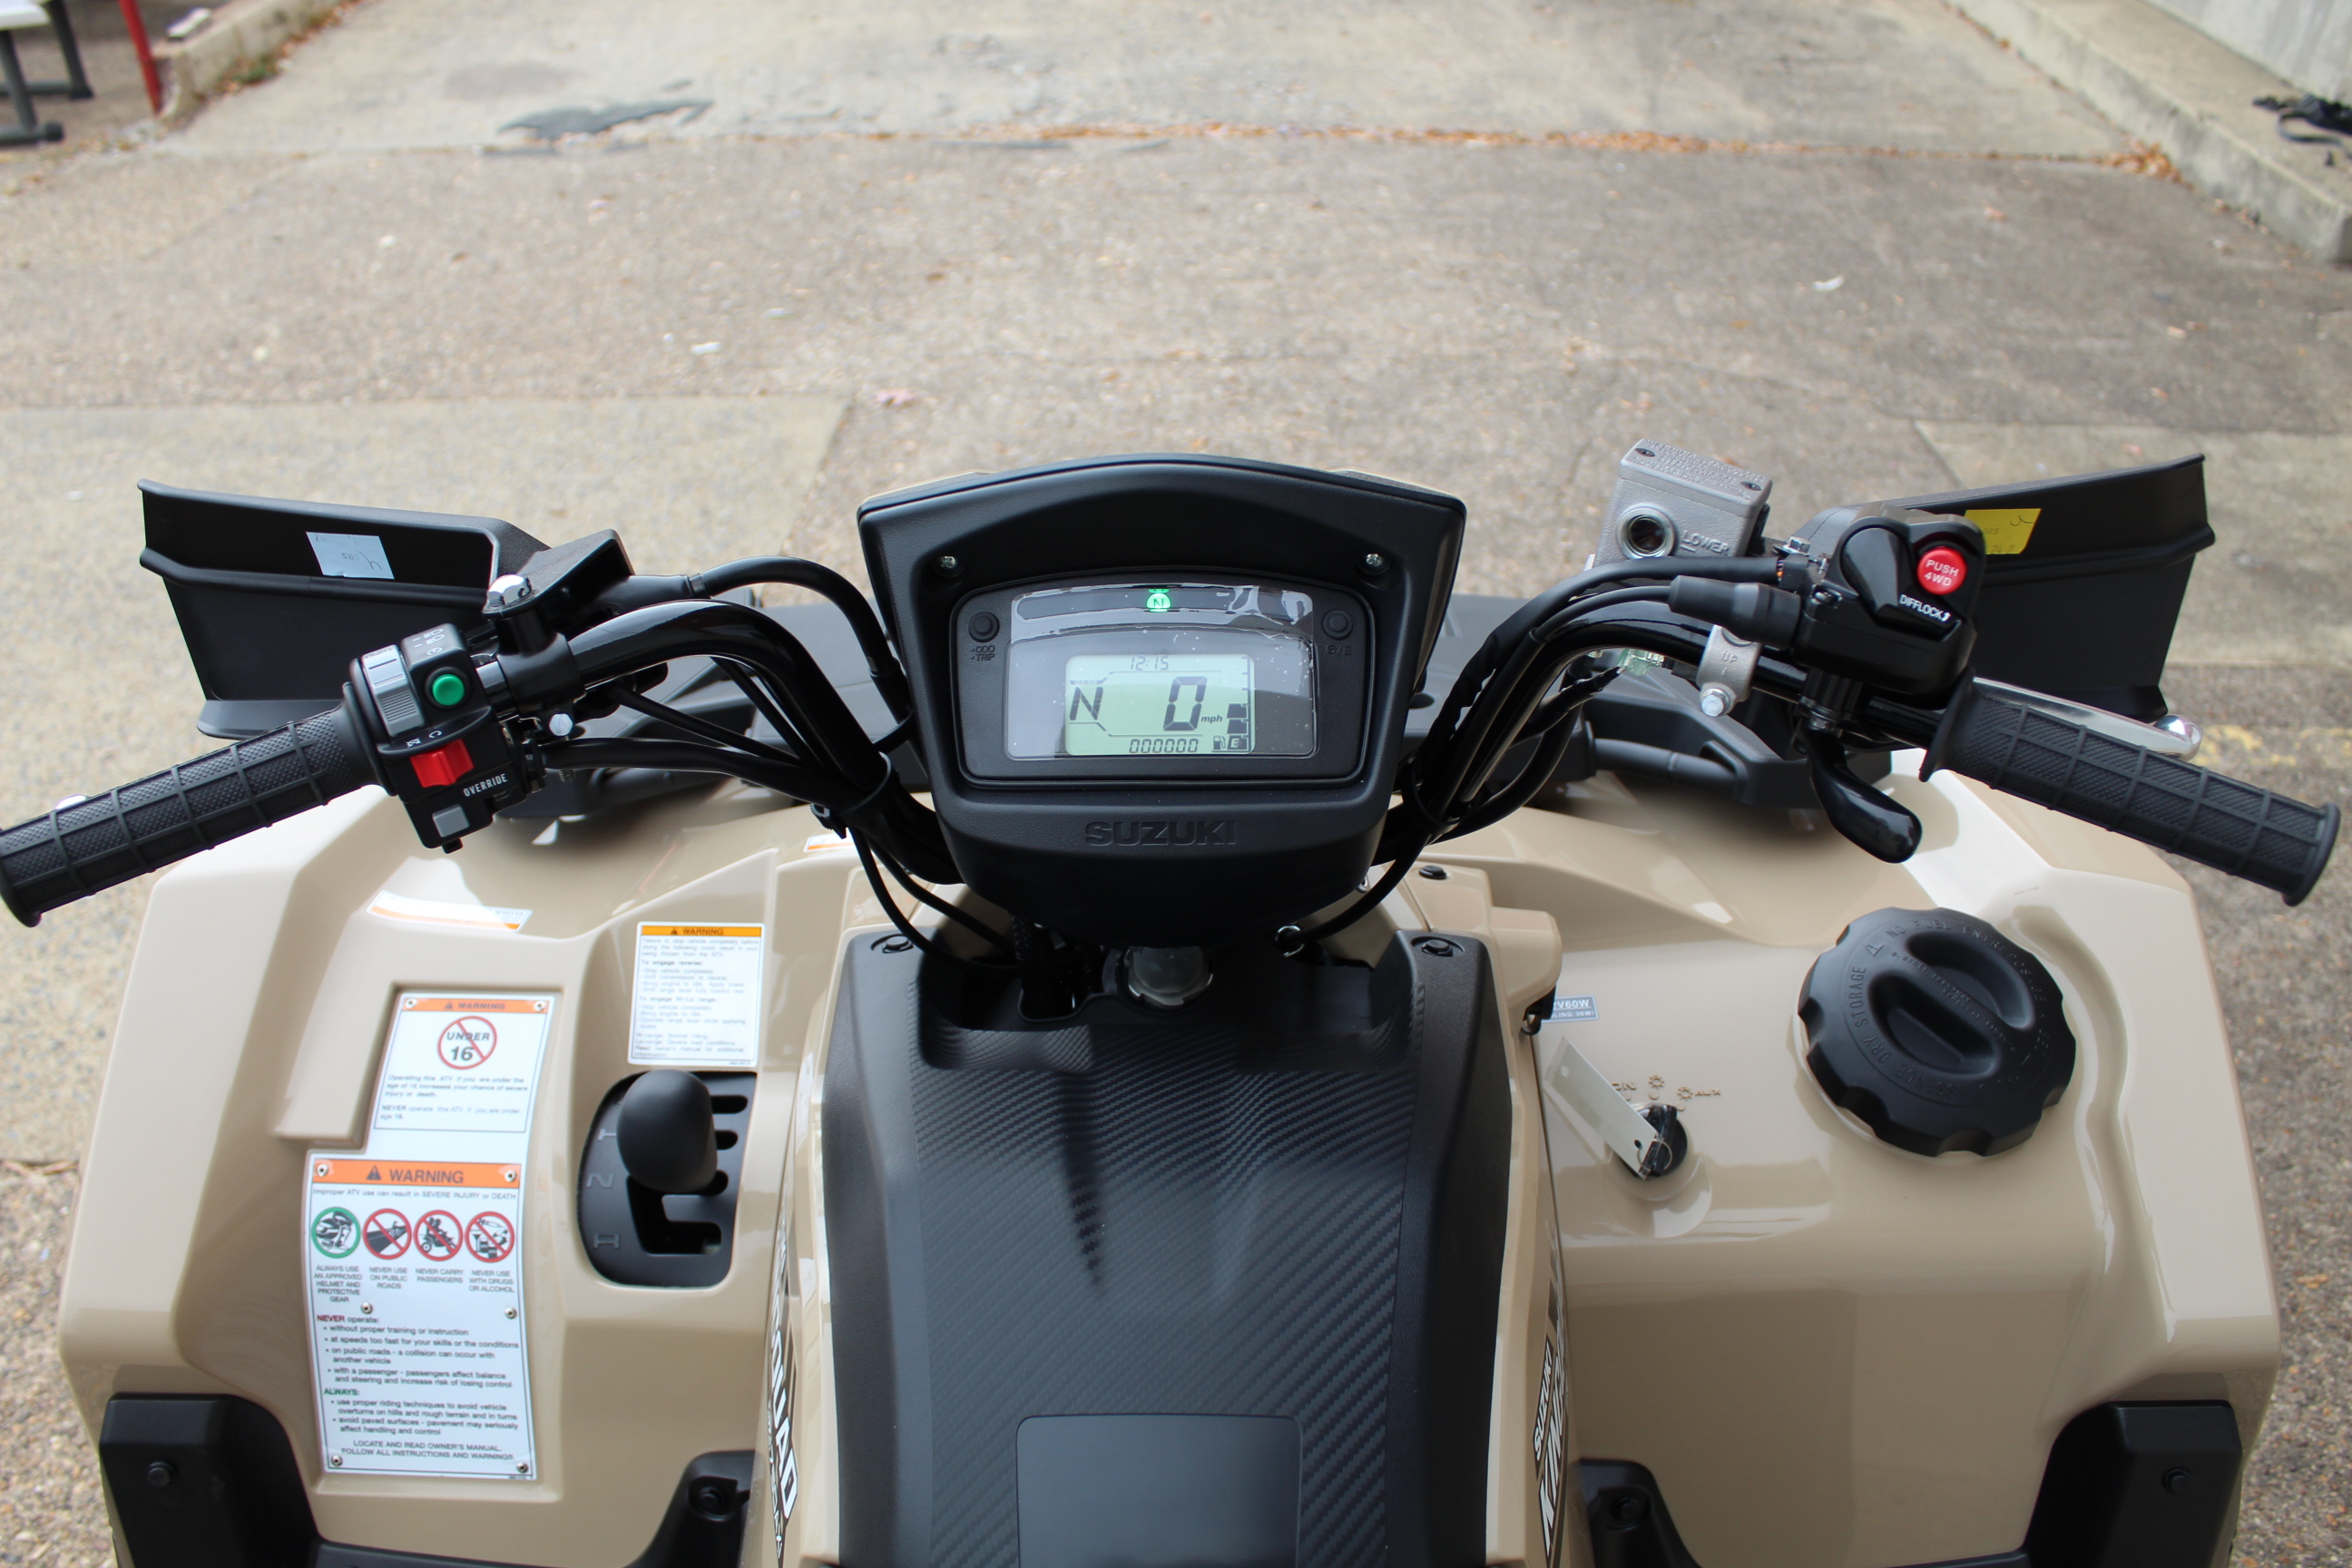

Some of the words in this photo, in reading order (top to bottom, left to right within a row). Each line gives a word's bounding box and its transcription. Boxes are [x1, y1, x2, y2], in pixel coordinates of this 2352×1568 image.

[1682, 530, 1730, 554] LOWER
[1926, 559, 1959, 577] PUSH
[1925, 572, 1953, 586] 4WD
[1153, 598, 1164, 607] N
[1899, 593, 1944, 620] DIFFLOCK
[975, 645, 995, 653] ODO
[1131, 656, 1169, 671] 12:15
[1069, 686, 1103, 720] N
[1163, 676, 1208, 730] 0
[1200, 714, 1223, 723] mph
[1129, 738, 1199, 753] 000000
[1230, 738, 1240, 748] E
[463, 773, 508, 797] OVERRIDE
[1085, 821, 1236, 846] SUZUKI
[1886, 924, 1906, 938] NO
[1848, 966, 1868, 1028] STORAGE
[457, 1002, 505, 1010] WARNING
[446, 1032, 489, 1041] UNDER
[452, 1046, 474, 1062] 16
[1865, 1034, 1892, 1064] DRY
[389, 1169, 464, 1183] WARNING
[313, 1188, 345, 1196] Improper
[349, 1376, 383, 1384] steering
[402, 1401, 445, 1409] techniques
[1534, 1341, 1553, 1461] SUZUKI
[359, 1417, 385, 1426] paved
[426, 1419, 465, 1428] pavement
[484, 1421, 518, 1430] seriously
[362, 1426, 397, 1434] handling
[341, 1447, 374, 1455] FOLLOW
[391, 1449, 450, 1458] INSTRUCTIONS
[426, 1442, 465, 1450] OWNER'S
